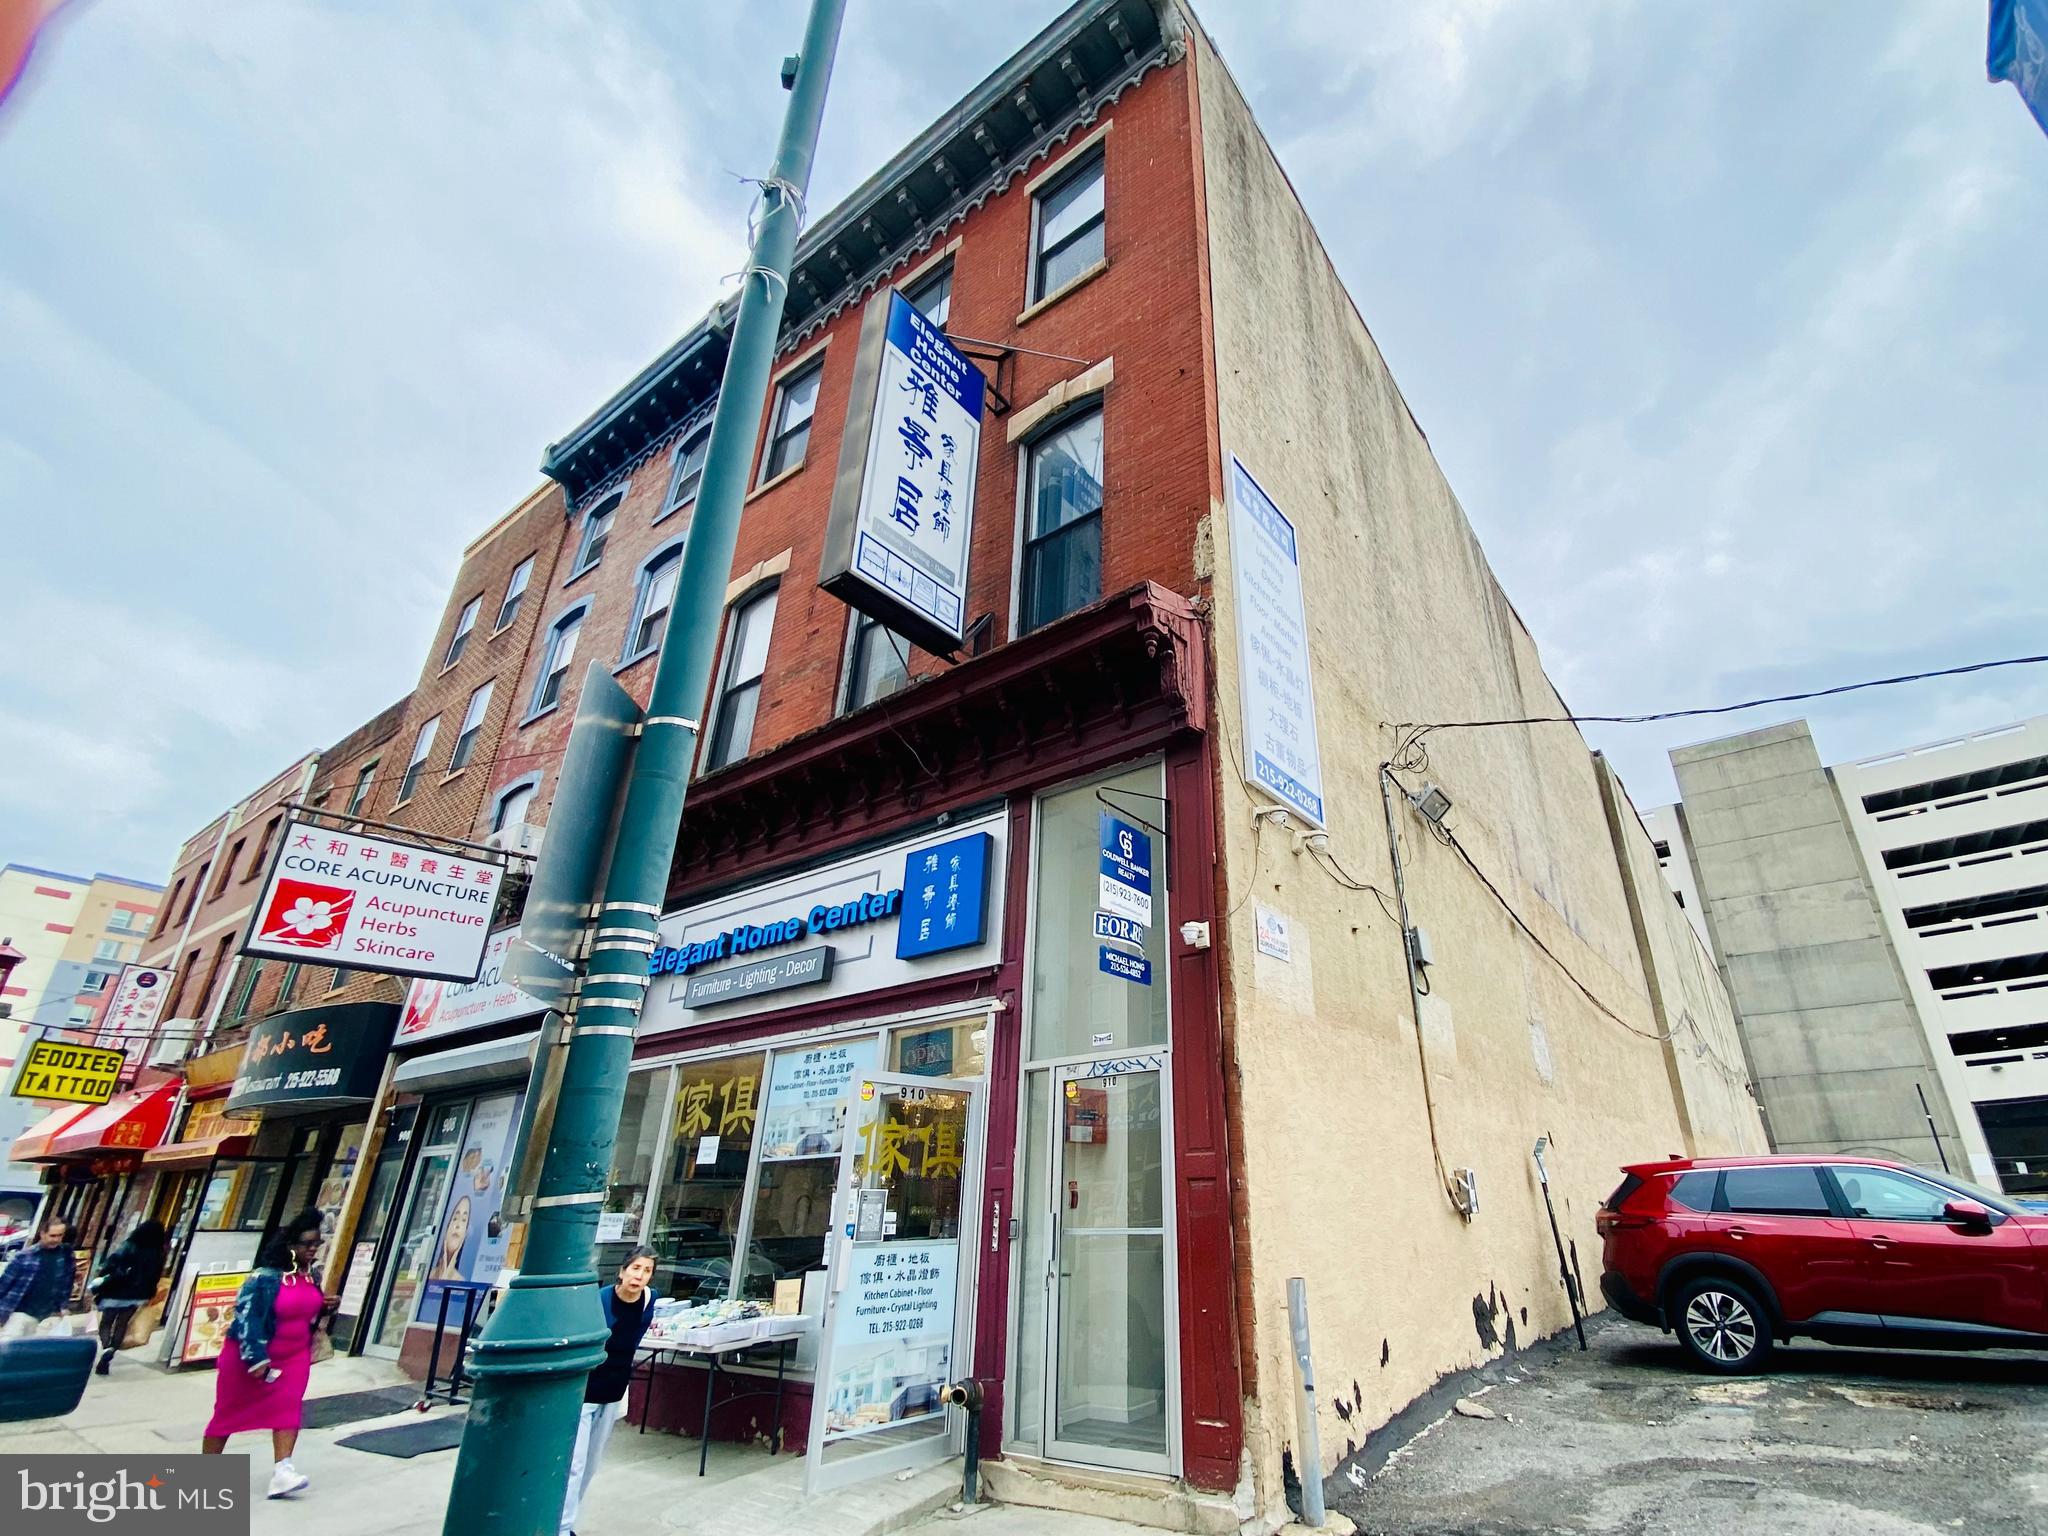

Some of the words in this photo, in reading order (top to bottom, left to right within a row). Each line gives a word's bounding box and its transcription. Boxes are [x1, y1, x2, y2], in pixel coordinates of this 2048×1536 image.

[910, 313, 968, 376] Elegant
[915, 335, 960, 383] Home
[910, 348, 962, 400] Center
[1243, 568, 1271, 601] Kitchen
[1250, 594, 1269, 619] Floor
[1258, 760, 1319, 815] 215-922-0268
[293, 834, 494, 885] 太和中醫養生堂
[1102, 849, 1130, 868] COLDWELL
[1130, 862, 1150, 878] BANKER
[284, 855, 342, 877] CORE
[347, 867, 491, 904] ACUPUNCTURE
[1118, 867, 1136, 881] REALTY
[366, 896, 485, 927] Acupuncture
[360, 916, 417, 937] Herbs
[649, 932, 726, 974] Elegant
[730, 917, 800, 954] Home
[807, 889, 899, 934] Center
[1098, 915, 1129, 938] FOR
[354, 938, 435, 962] Skincare
[1106, 952, 1130, 966] MICHAEL
[692, 977, 731, 998] Furniture
[739, 967, 777, 990] Lighting
[786, 956, 817, 977] Decor
[439, 1001, 487, 1023] Acupuncture
[493, 990, 517, 1009] Herbs
[33, 1047, 121, 1073] EDDIES
[905, 1043, 948, 1067] OPEN
[25, 1072, 112, 1097] TATTOO
[901, 1087, 925, 1100] 910
[1103, 1077, 1116, 1087] 910
[908, 1252, 930, 1264] 地板
[864, 1289, 888, 1300] Kitchen
[889, 1287, 914, 1299] Cabinet
[917, 1287, 933, 1296] Floor
[856, 1304, 887, 1315] Furniture
[890, 1302, 913, 1314] Crystal
[913, 1300, 938, 1312] Lighting
[882, 1317, 924, 1333] 215-922-0268
